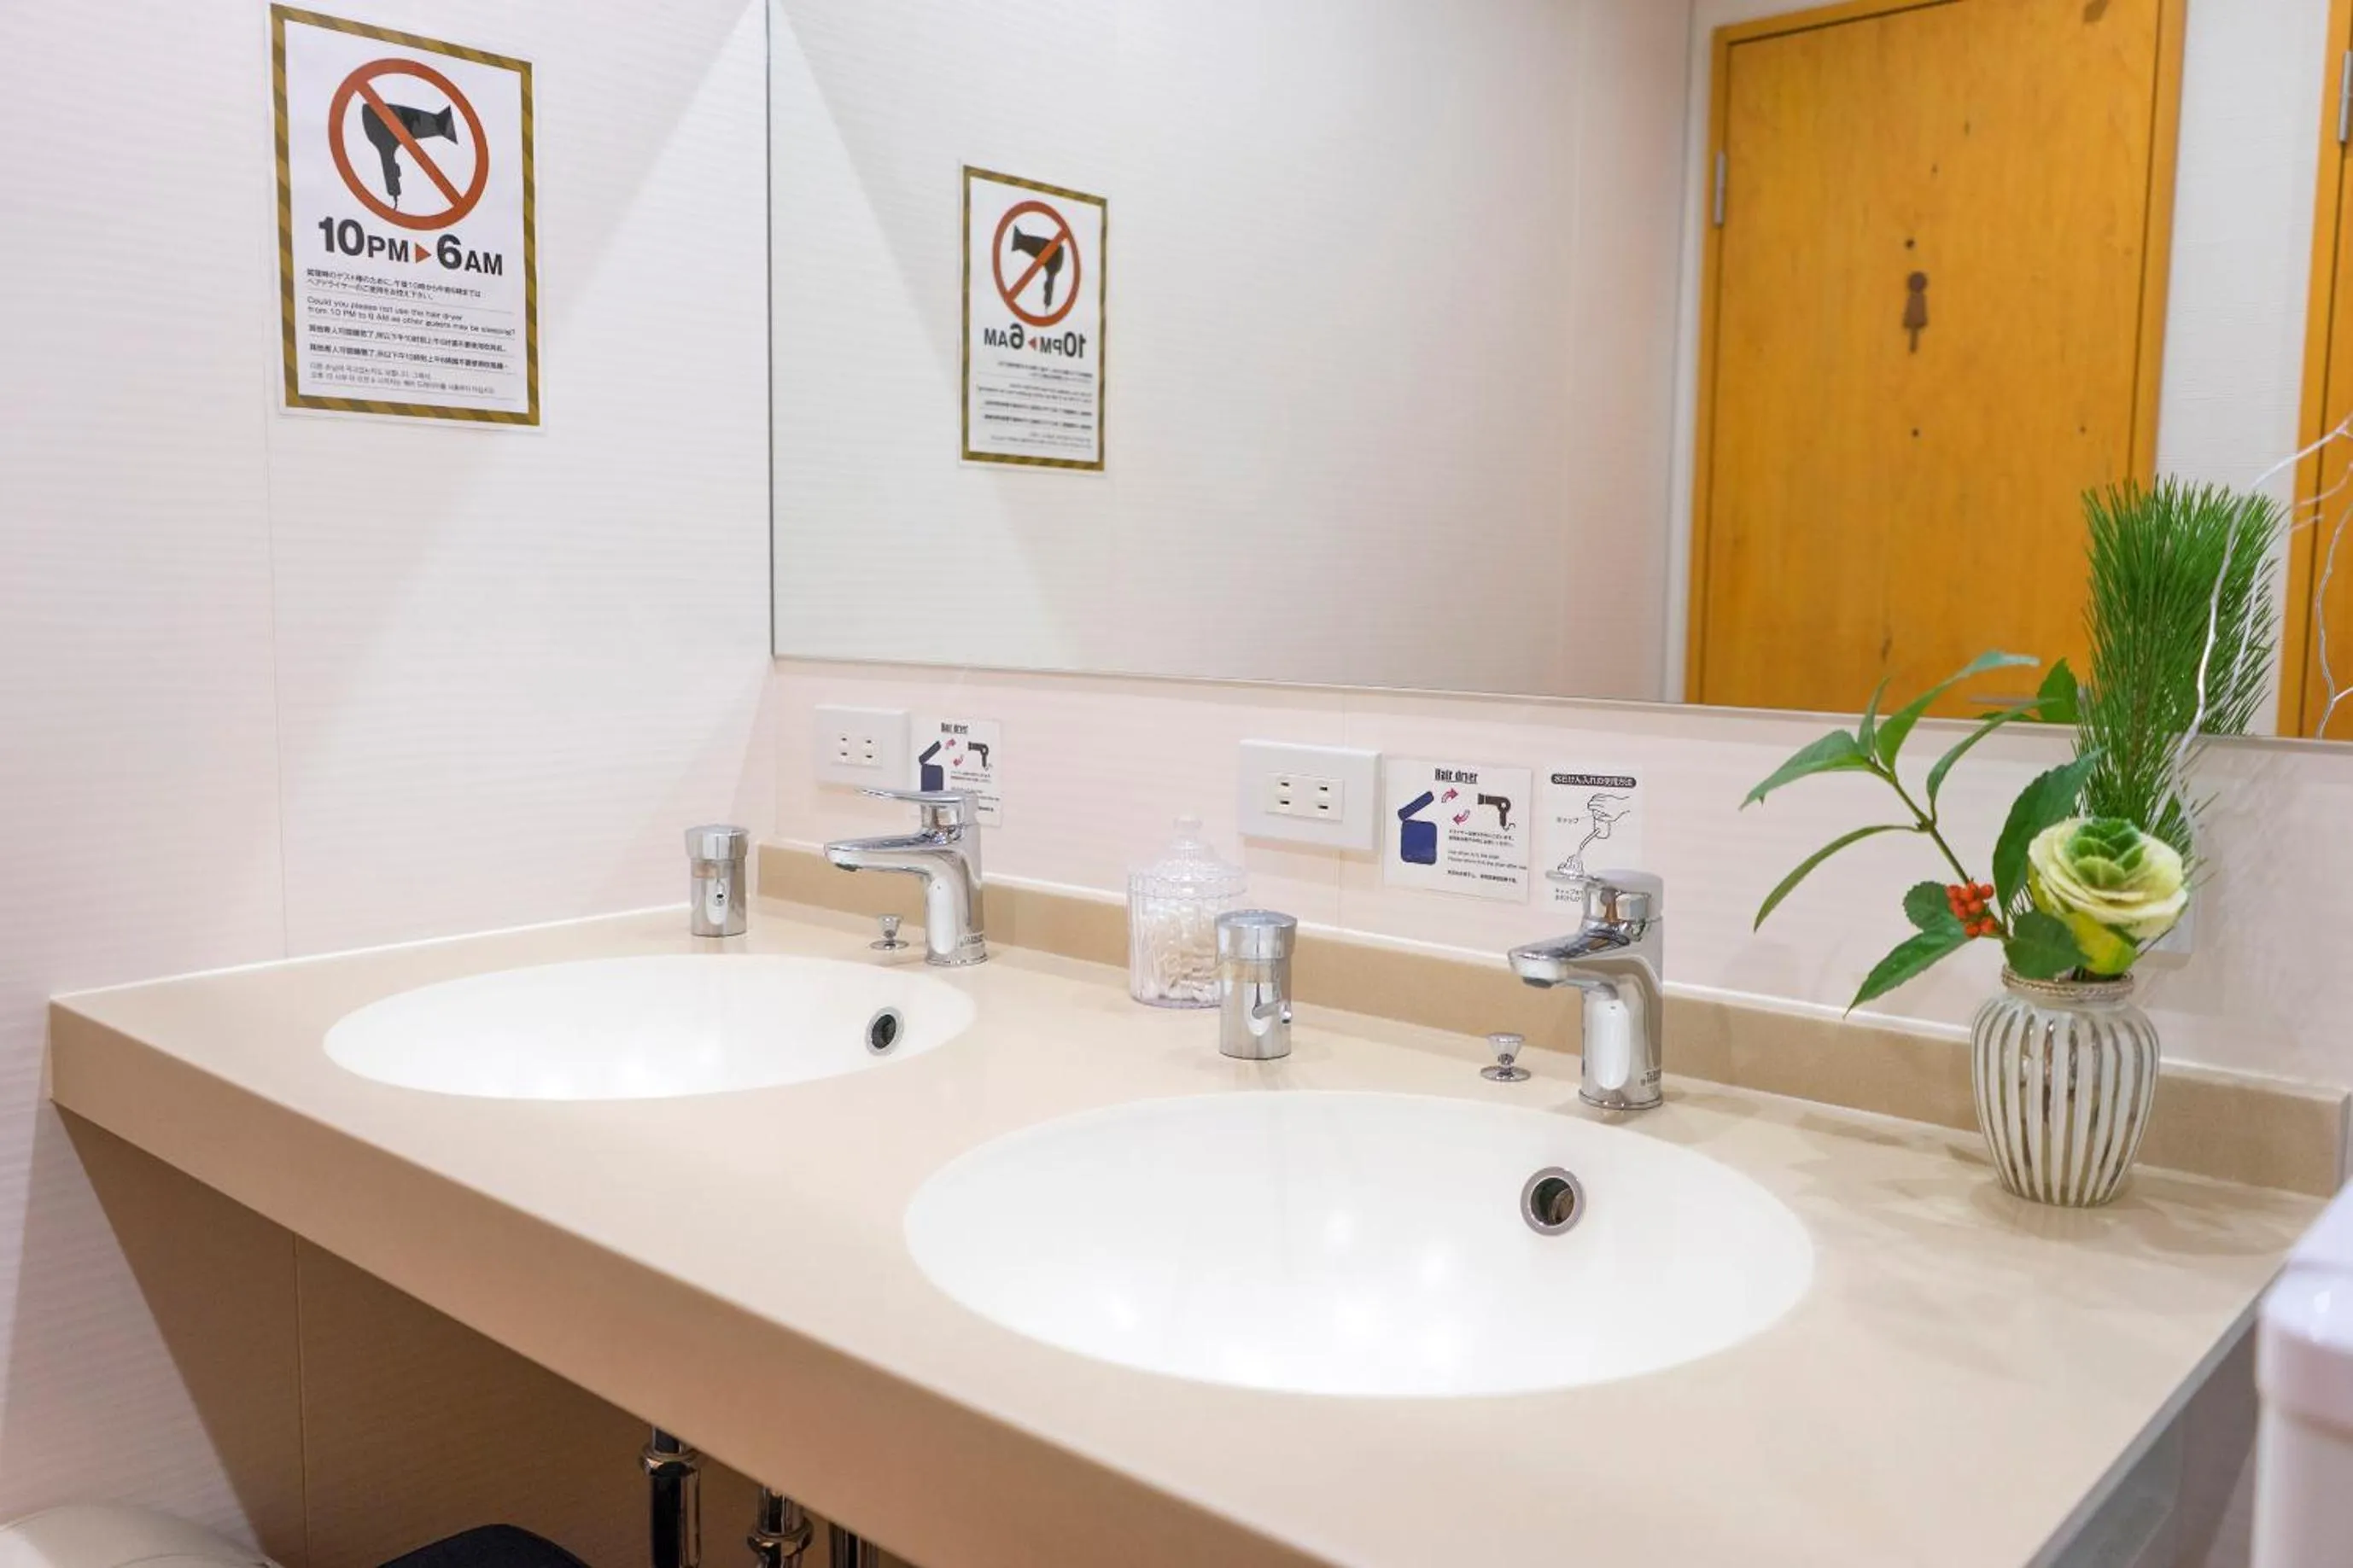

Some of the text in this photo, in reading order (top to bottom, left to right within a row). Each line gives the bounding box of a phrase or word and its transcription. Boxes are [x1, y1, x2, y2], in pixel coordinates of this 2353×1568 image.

[318, 216, 503, 276] 10PM 6AM
[307, 295, 332, 306] Could
[334, 300, 349, 308] you
[351, 302, 378, 312] please
[426, 311, 441, 319] hair
[442, 312, 464, 322] dryer
[307, 306, 328, 315] from
[330, 308, 342, 317] 10
[343, 309, 357, 318] PM
[359, 312, 368, 320] to
[376, 313, 389, 322] AM
[402, 317, 423, 325] other
[425, 319, 452, 329] guests
[452, 323, 469, 331] may
[470, 324, 479, 333] be
[1434, 767, 1478, 784] Hair dryer
